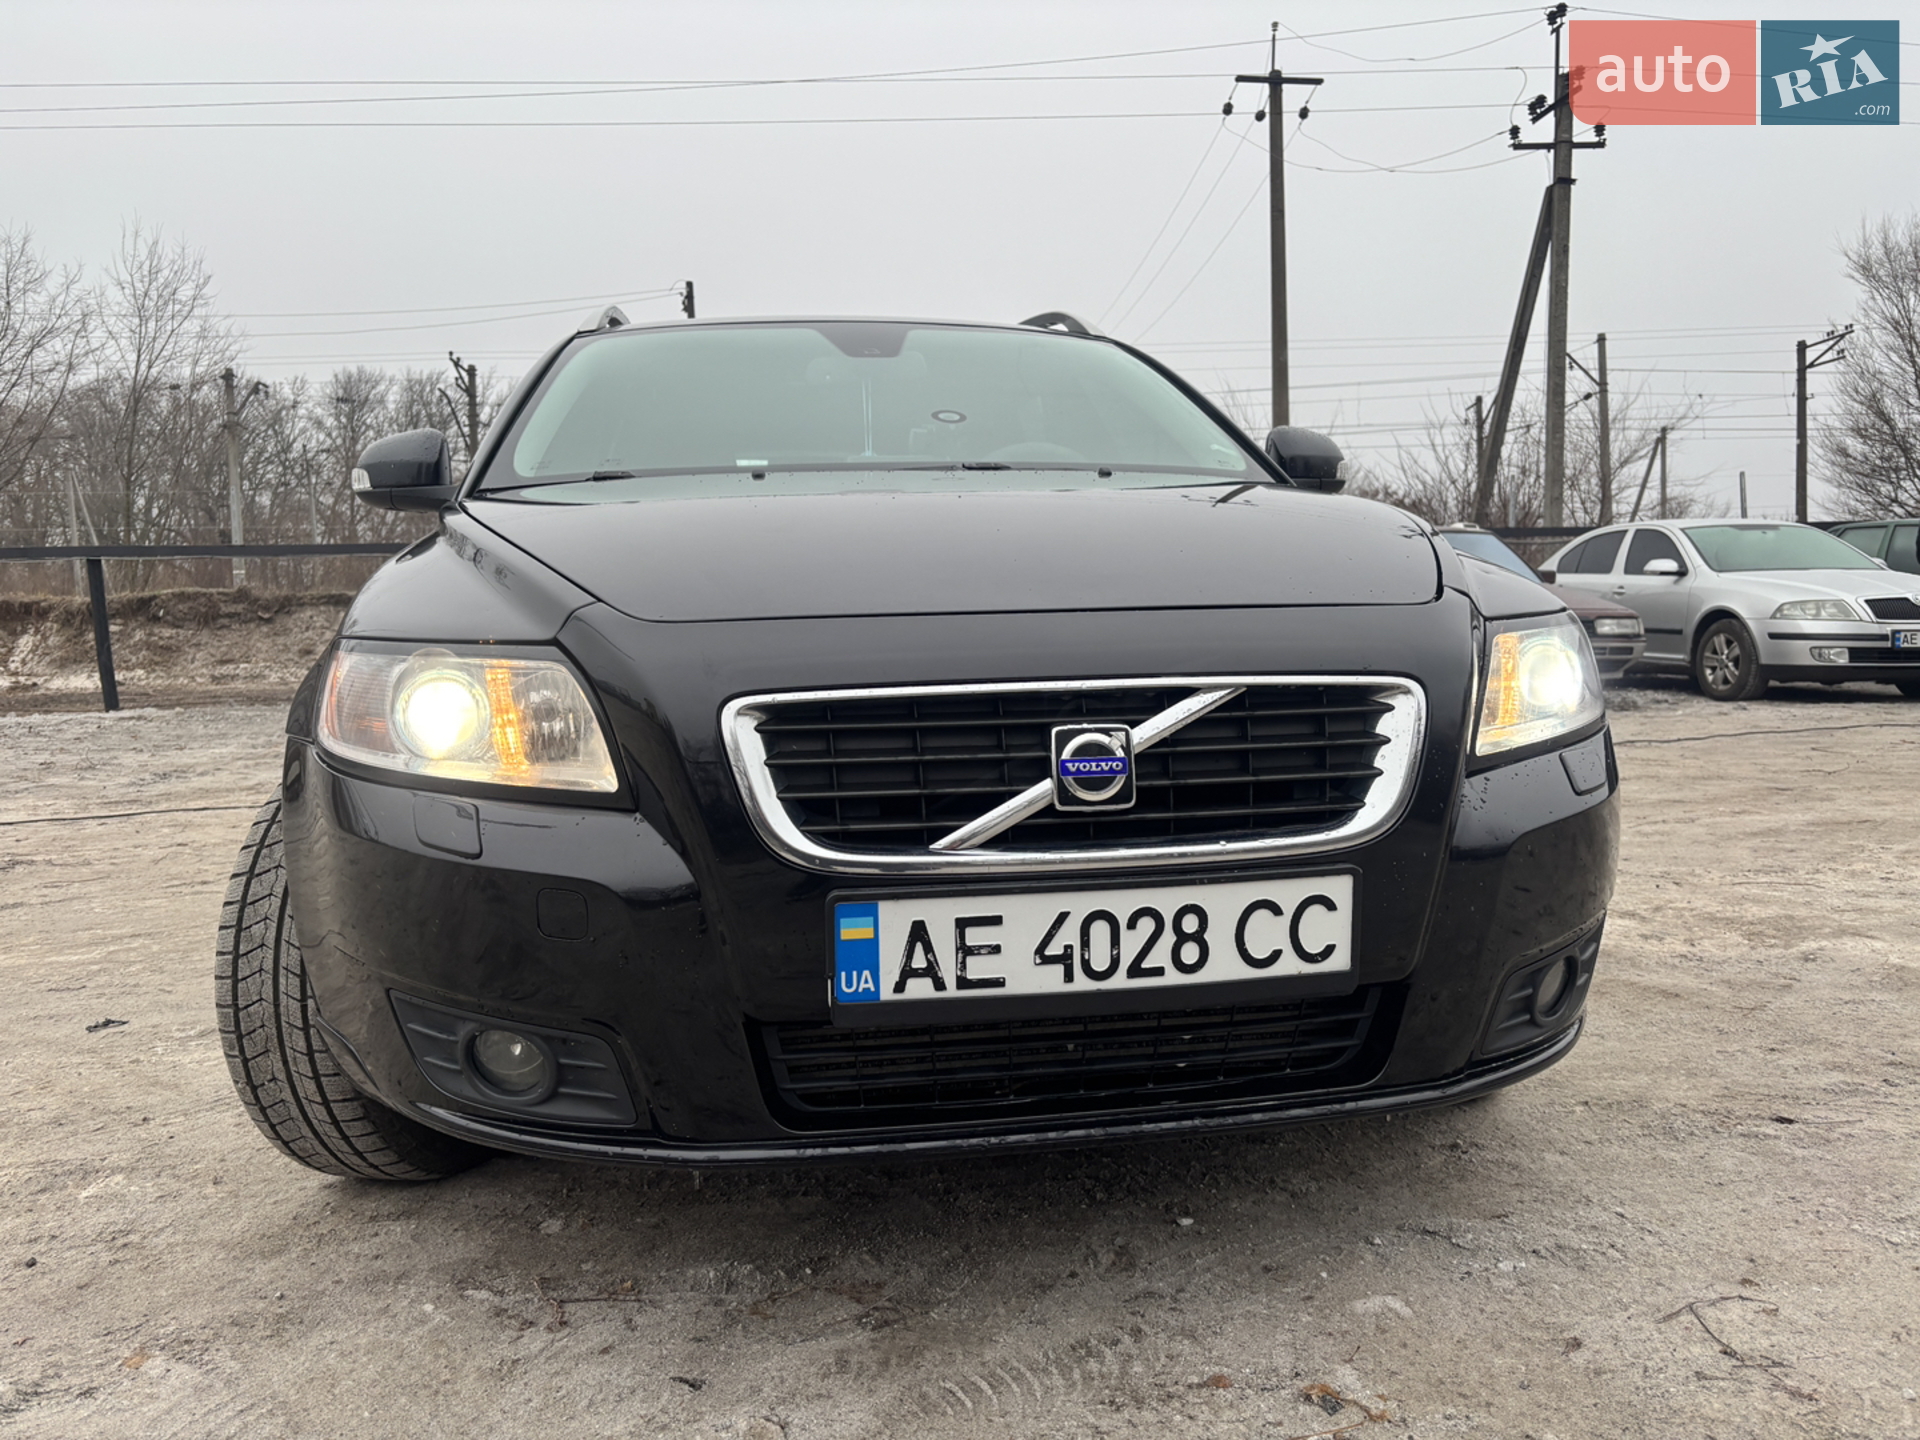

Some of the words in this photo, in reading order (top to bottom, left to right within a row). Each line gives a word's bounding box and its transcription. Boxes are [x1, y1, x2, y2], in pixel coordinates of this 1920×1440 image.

[1901, 633, 1918, 645] AE
[1065, 761, 1123, 772] VOLVO
[893, 915, 1006, 993] AE
[1034, 903, 1209, 983] 4028
[1235, 894, 1339, 968] CC
[840, 970, 875, 993] UA
